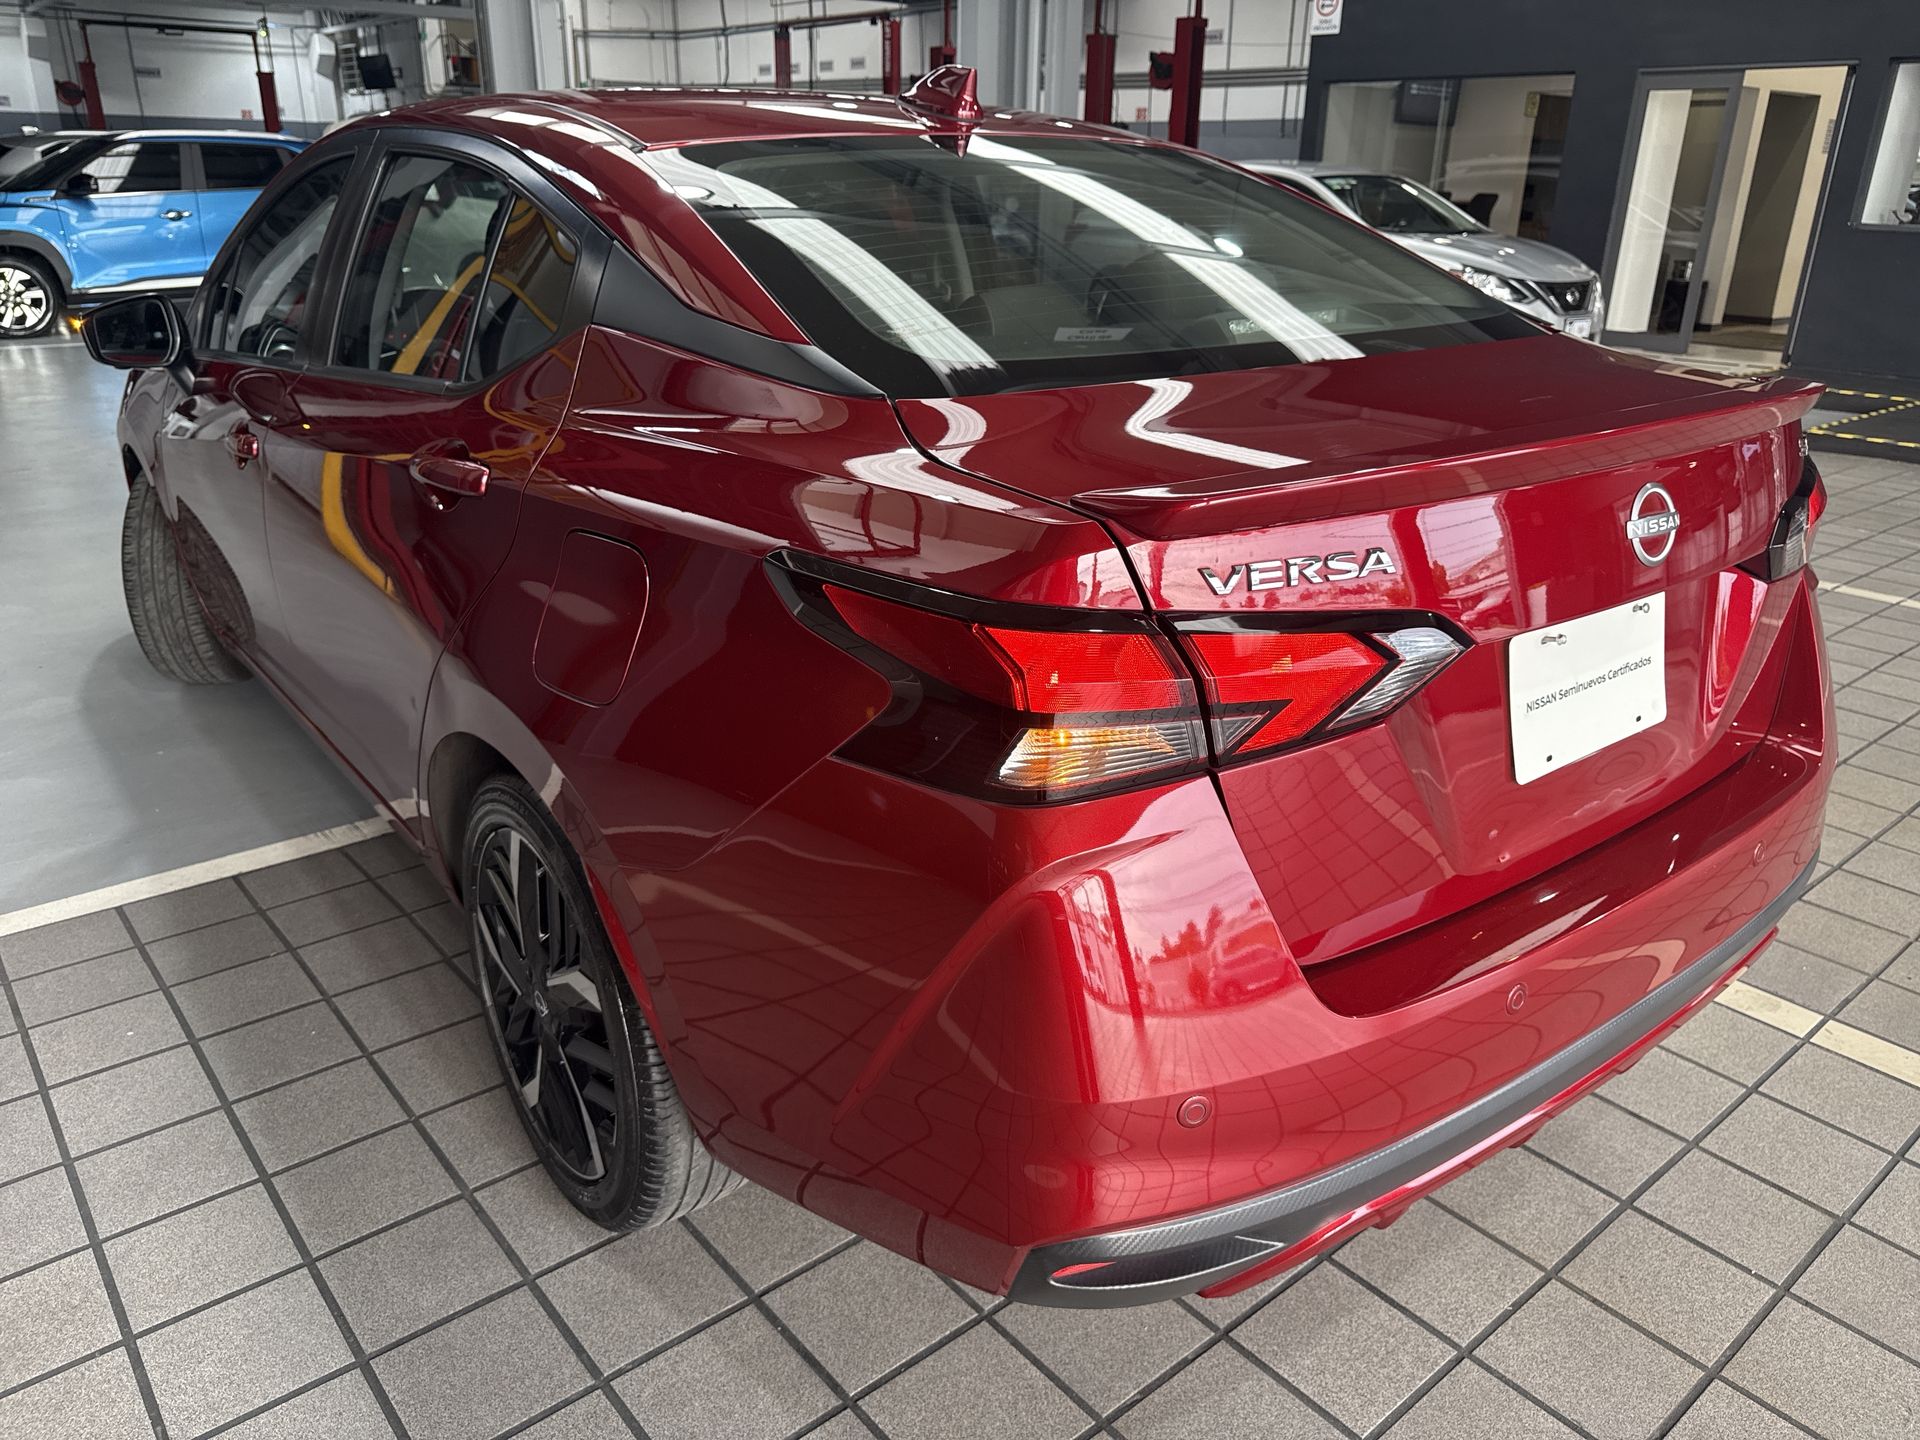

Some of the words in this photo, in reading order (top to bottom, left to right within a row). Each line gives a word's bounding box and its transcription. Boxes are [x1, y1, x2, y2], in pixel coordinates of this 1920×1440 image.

[1630, 513, 1680, 537] NISSAN
[1197, 546, 1397, 596] VERSA
[1526, 691, 1557, 714] NISSAN
[1558, 674, 1607, 701] Seminuevos
[1607, 655, 1652, 681] Certificados
